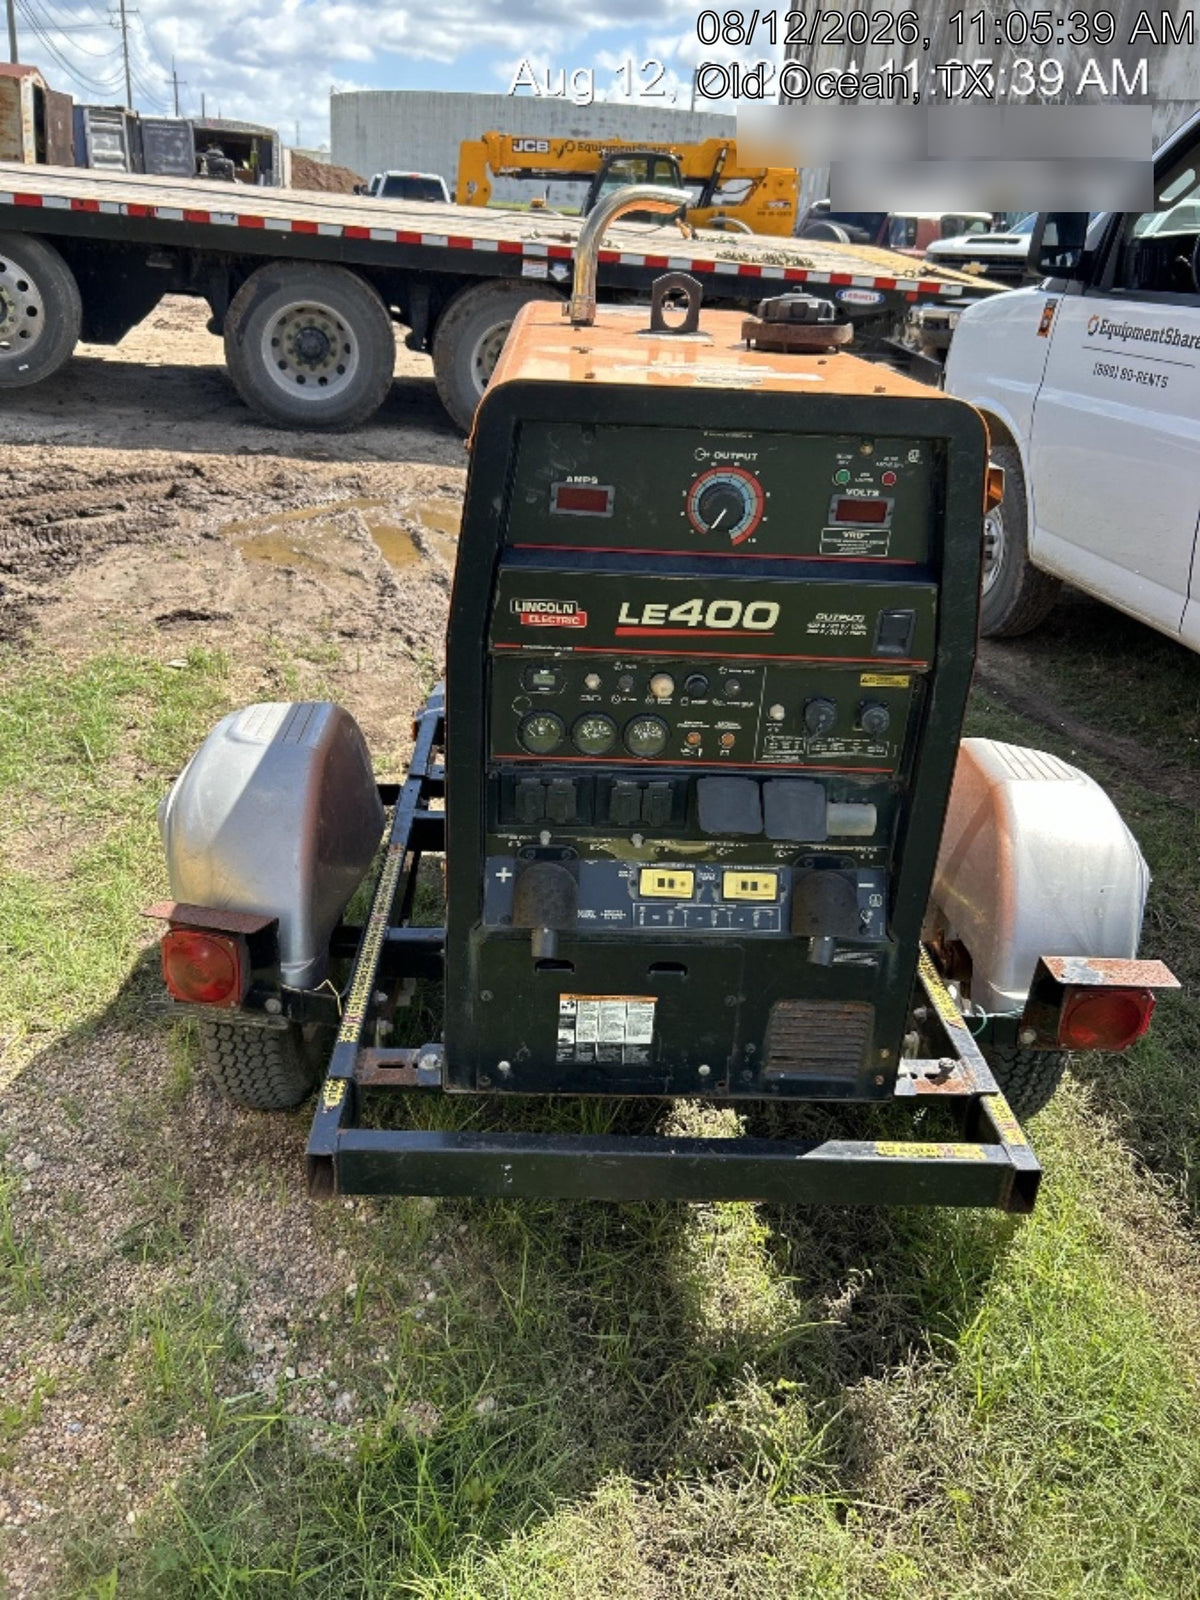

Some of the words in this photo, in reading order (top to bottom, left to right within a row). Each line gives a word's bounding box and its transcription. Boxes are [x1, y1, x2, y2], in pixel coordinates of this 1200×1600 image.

[512, 140, 549, 152] JCB
[1099, 319, 1200, 349] EquipmentShare
[713, 451, 759, 462] OUTPUT
[565, 475, 599, 485] AMPS
[514, 600, 574, 614] LINCOLN
[528, 614, 580, 625] ELECTRIC
[616, 598, 779, 630] LE400
